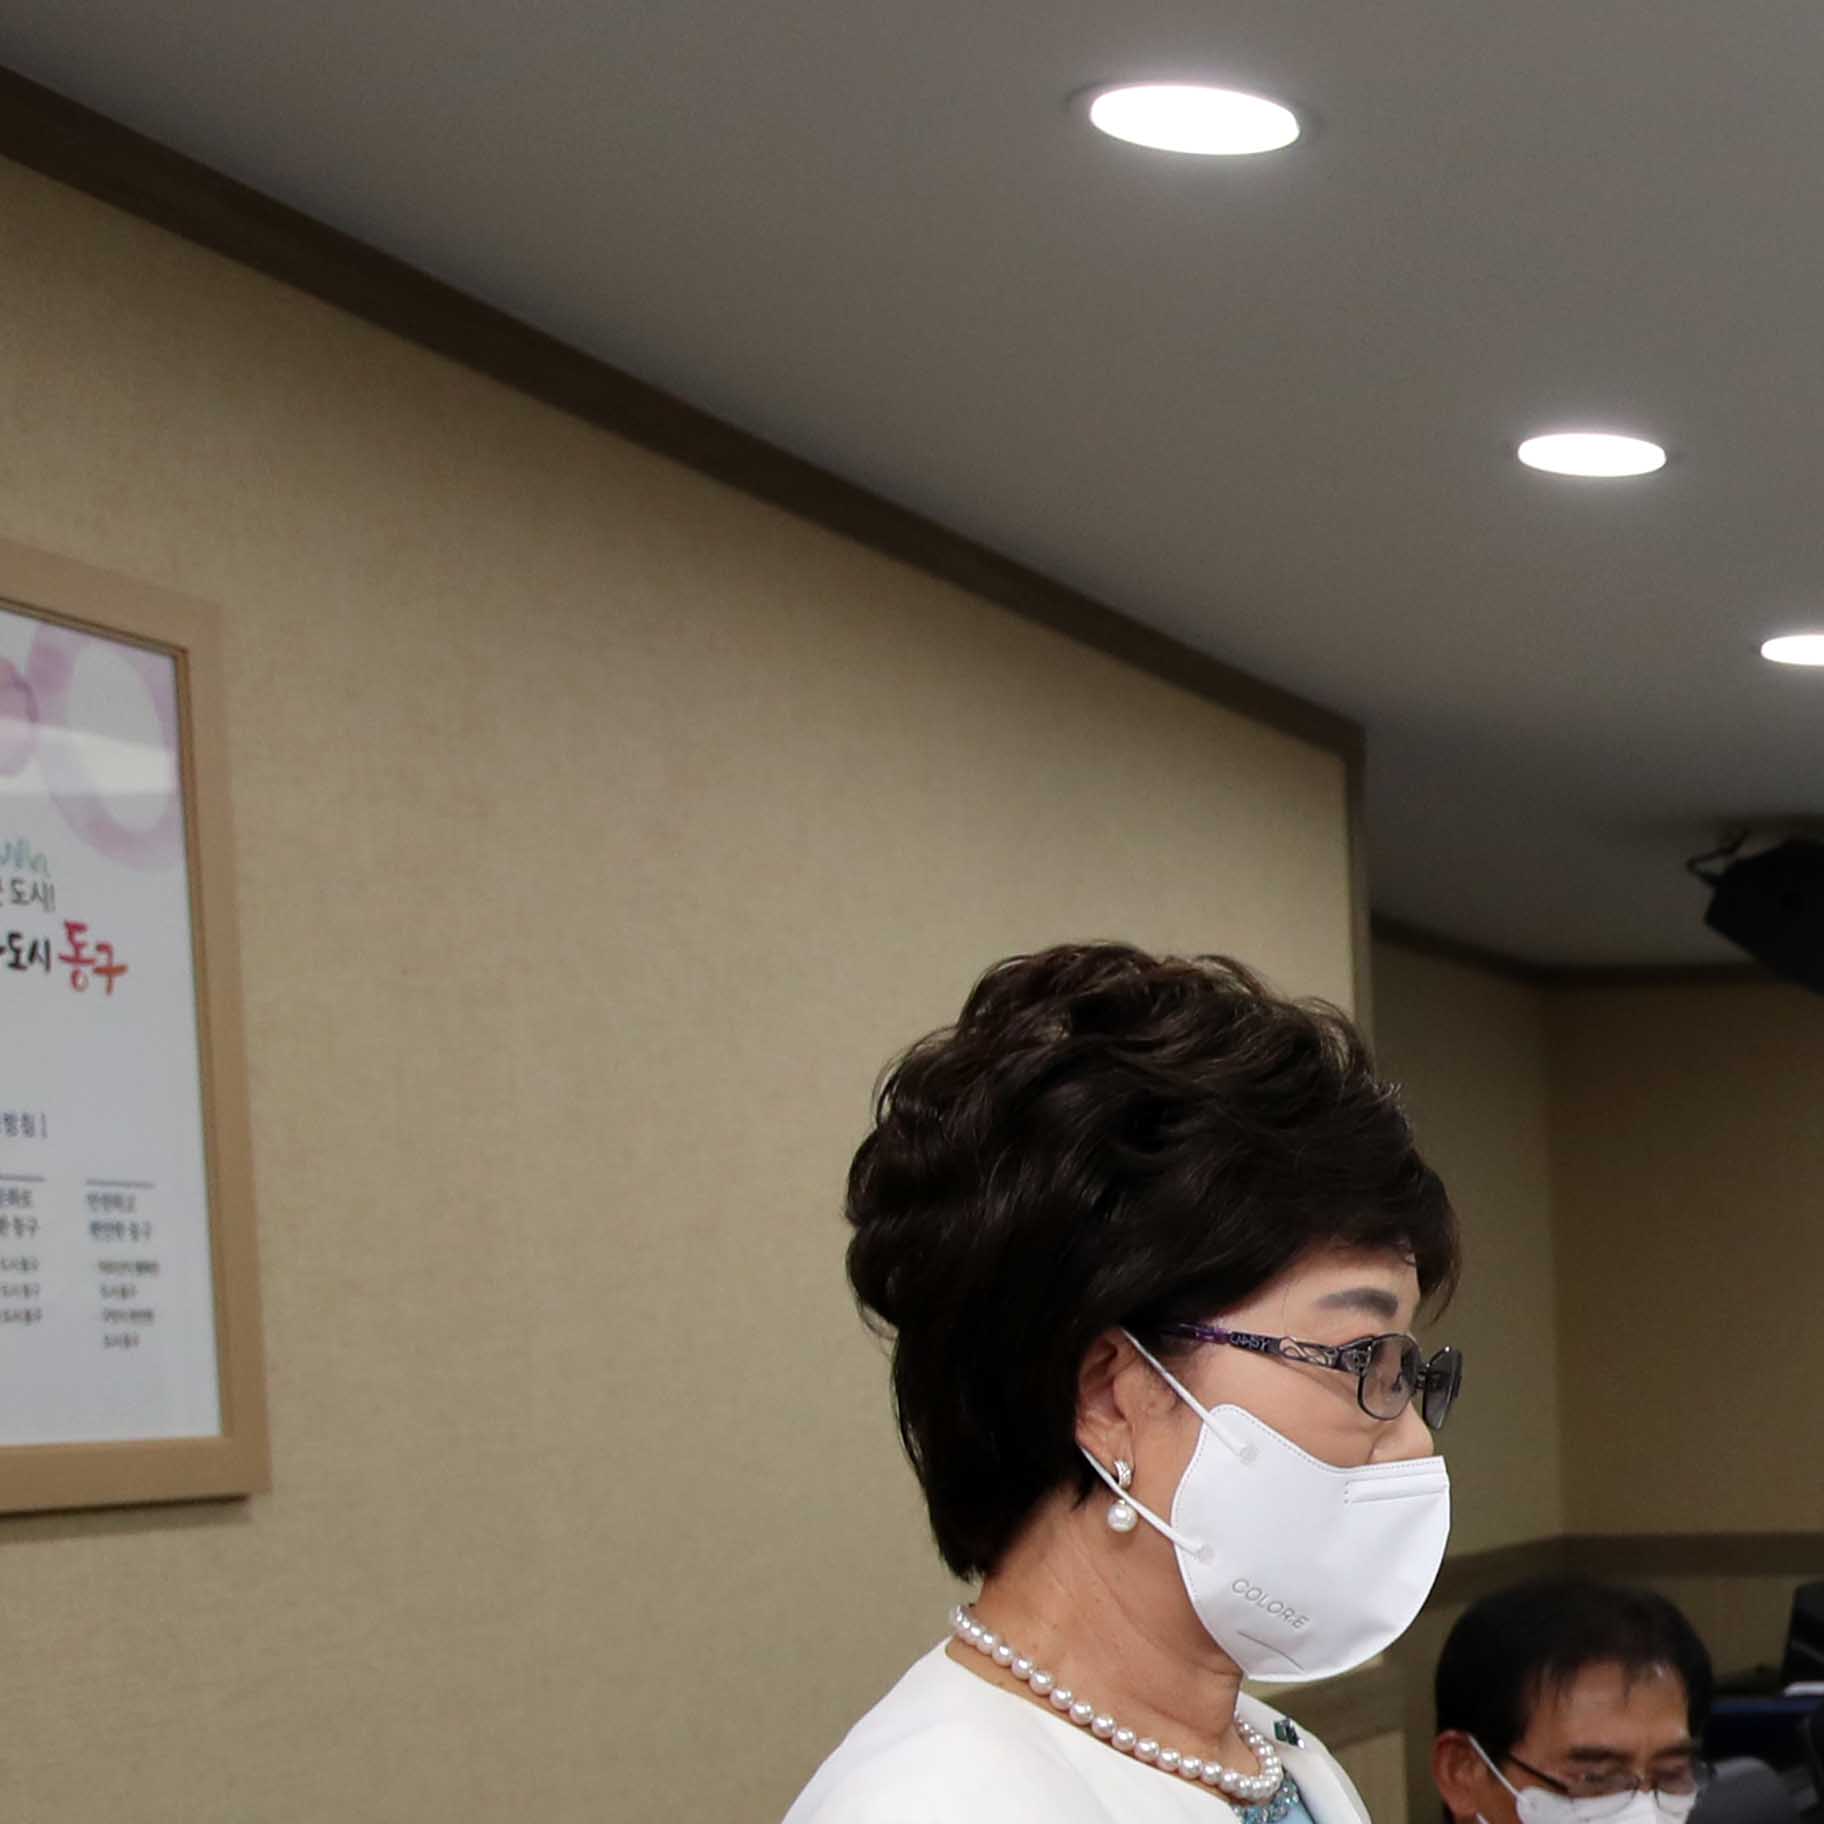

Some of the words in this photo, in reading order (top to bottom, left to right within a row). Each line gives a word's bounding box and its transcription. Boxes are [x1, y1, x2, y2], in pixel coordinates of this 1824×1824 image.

[0, 930, 52, 974] 도시
[58, 919, 129, 996] 동구
[1231, 1578, 1311, 1629] COLORE
